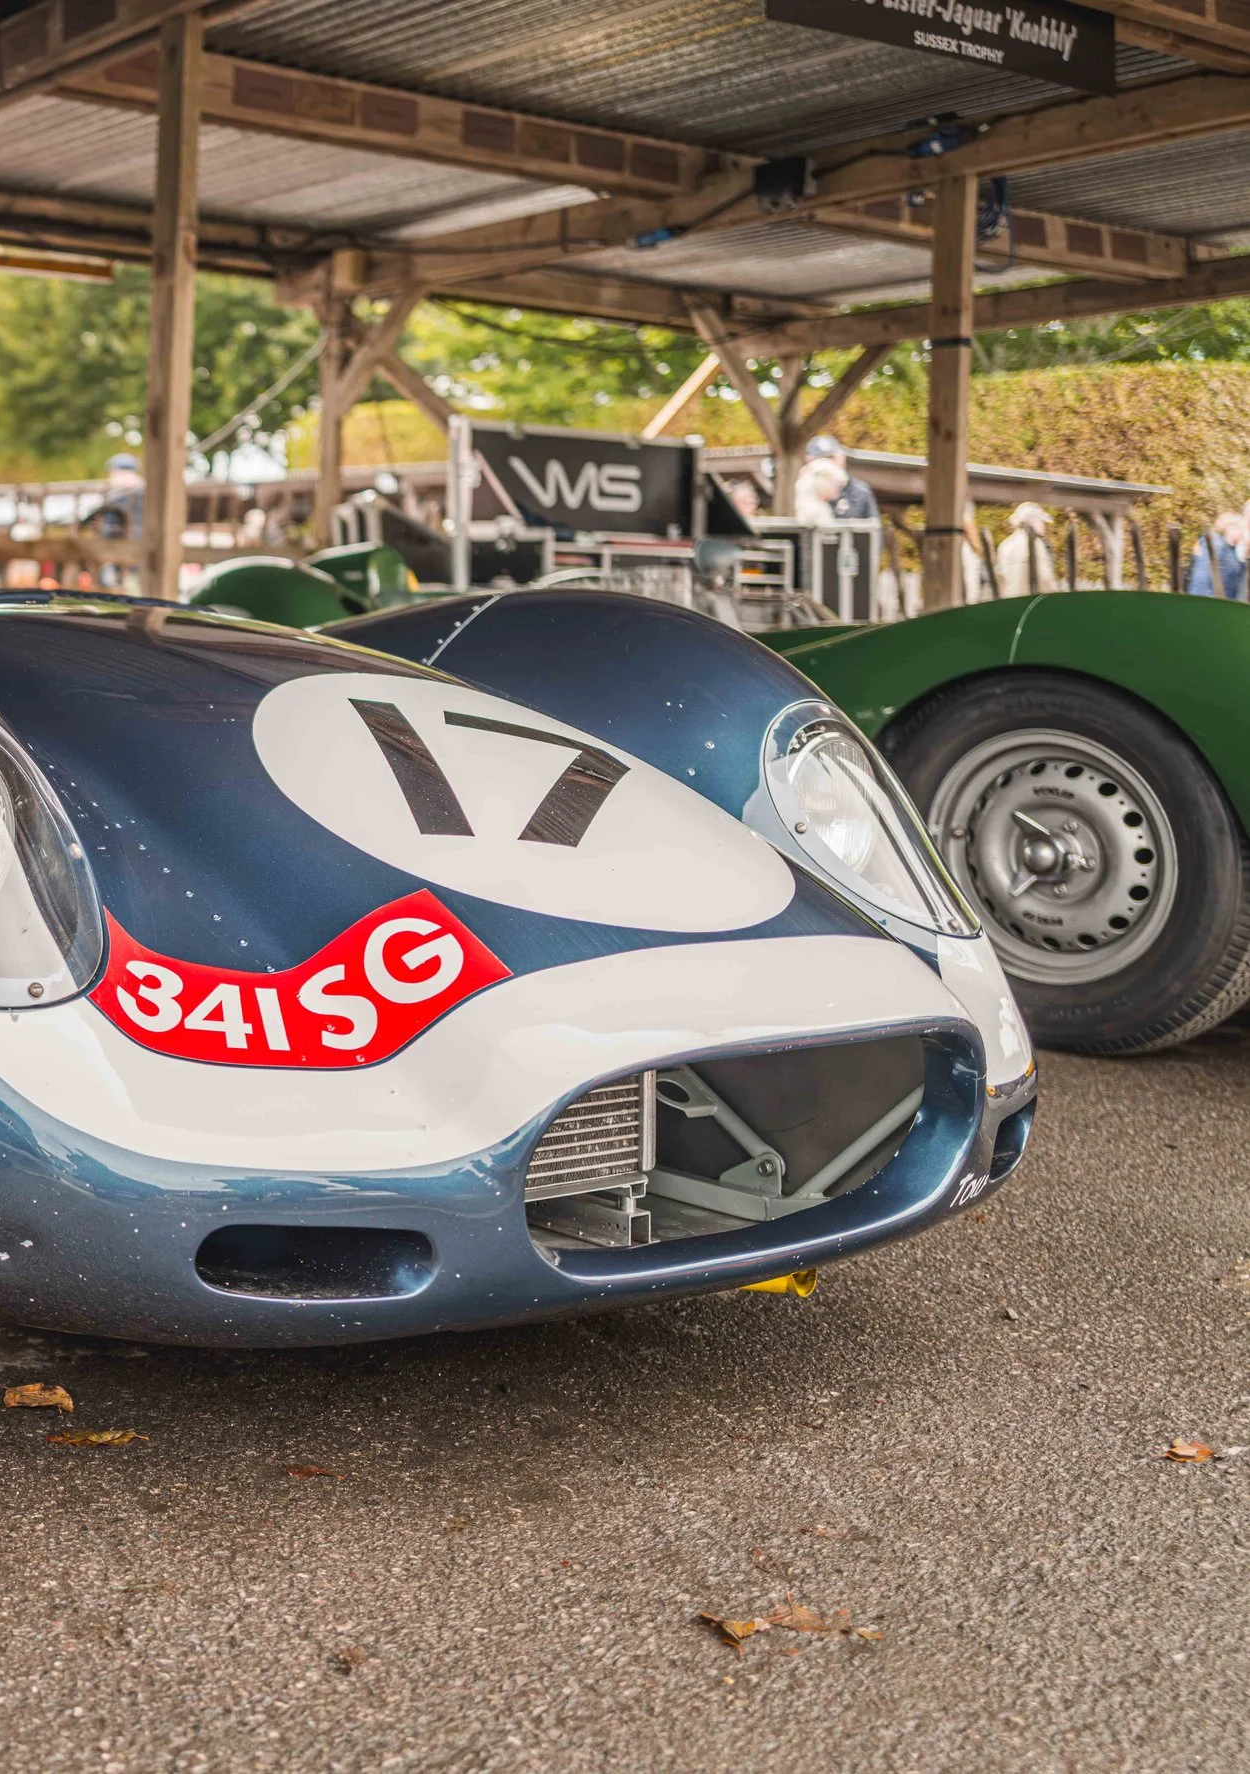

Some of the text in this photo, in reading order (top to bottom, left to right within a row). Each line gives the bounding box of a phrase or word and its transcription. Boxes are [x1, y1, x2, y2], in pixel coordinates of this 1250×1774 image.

[913, 30, 1005, 65] SUSSEX TROPHY
[347, 698, 631, 848] 17
[949, 1172, 990, 1208] TOW
